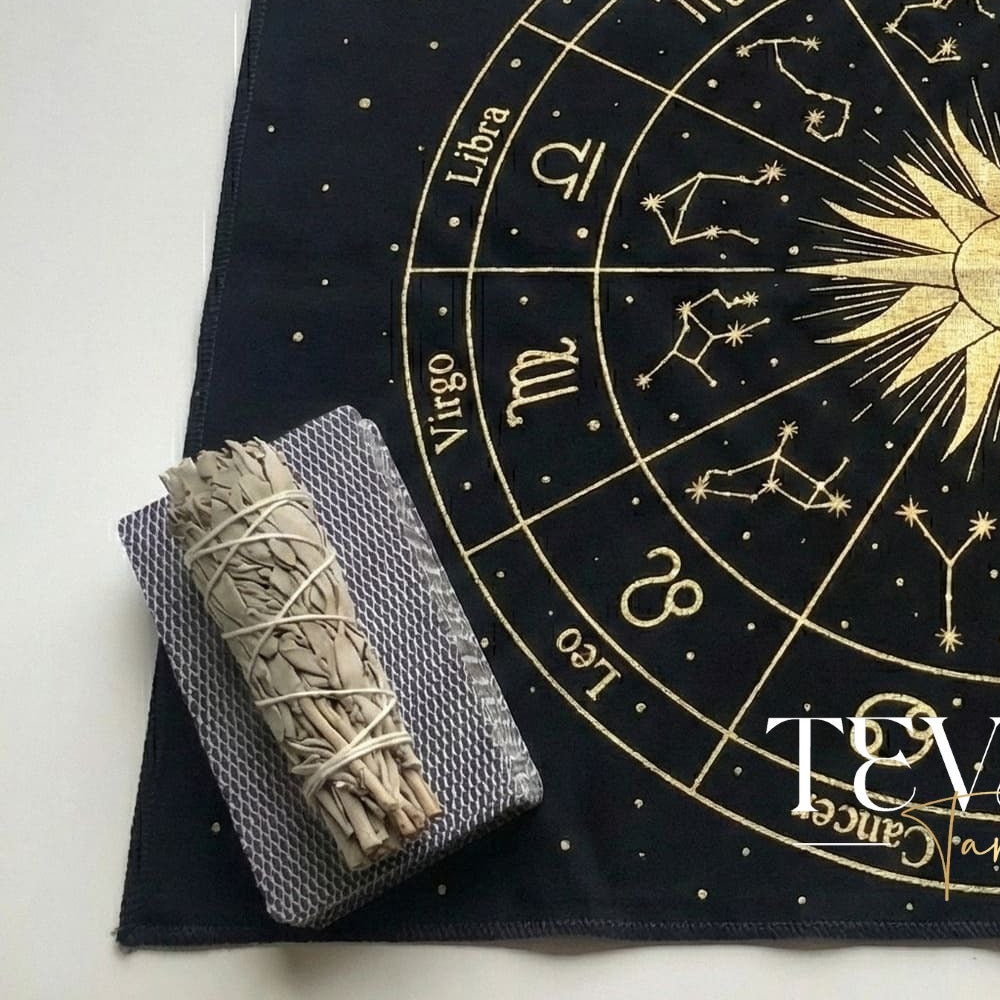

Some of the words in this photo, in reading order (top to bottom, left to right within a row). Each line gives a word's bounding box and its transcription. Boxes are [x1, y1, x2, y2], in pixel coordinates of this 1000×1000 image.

[445, 106, 510, 187] Libra
[428, 353, 468, 455] Virgo
[556, 627, 623, 702] Leo
[791, 793, 935, 868] Cance
